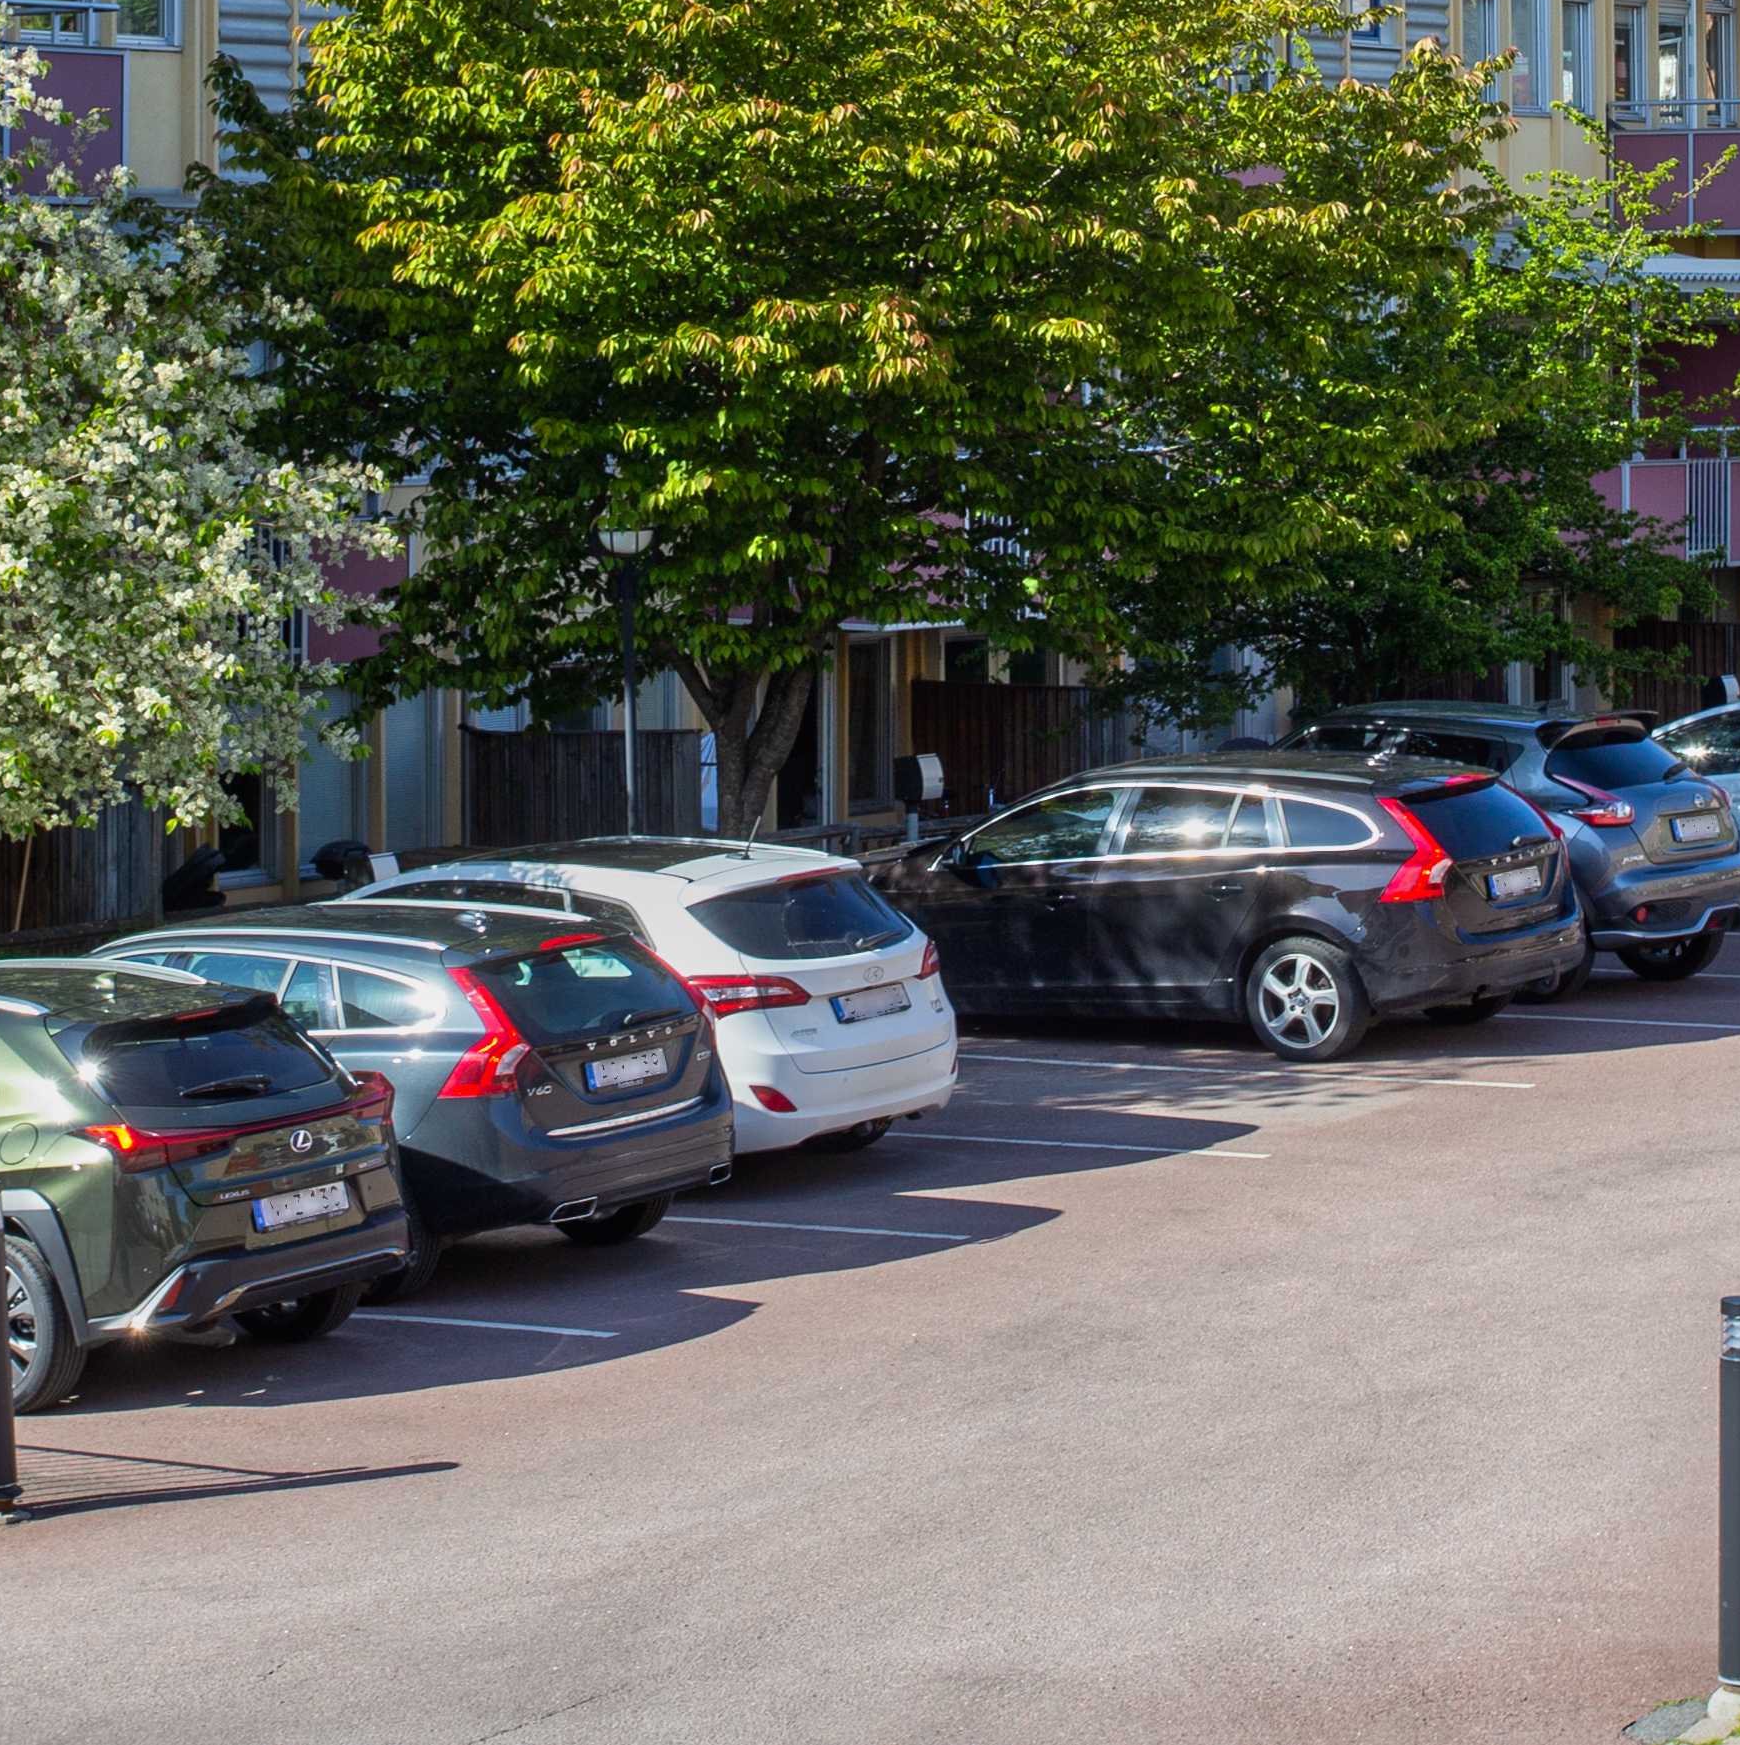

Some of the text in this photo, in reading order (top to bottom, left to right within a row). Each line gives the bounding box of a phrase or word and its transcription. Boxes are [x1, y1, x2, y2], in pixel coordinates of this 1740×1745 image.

[586, 1026, 673, 1051] VOLVO
[526, 1085, 553, 1097] V60
[219, 1188, 251, 1200] LEXUS
